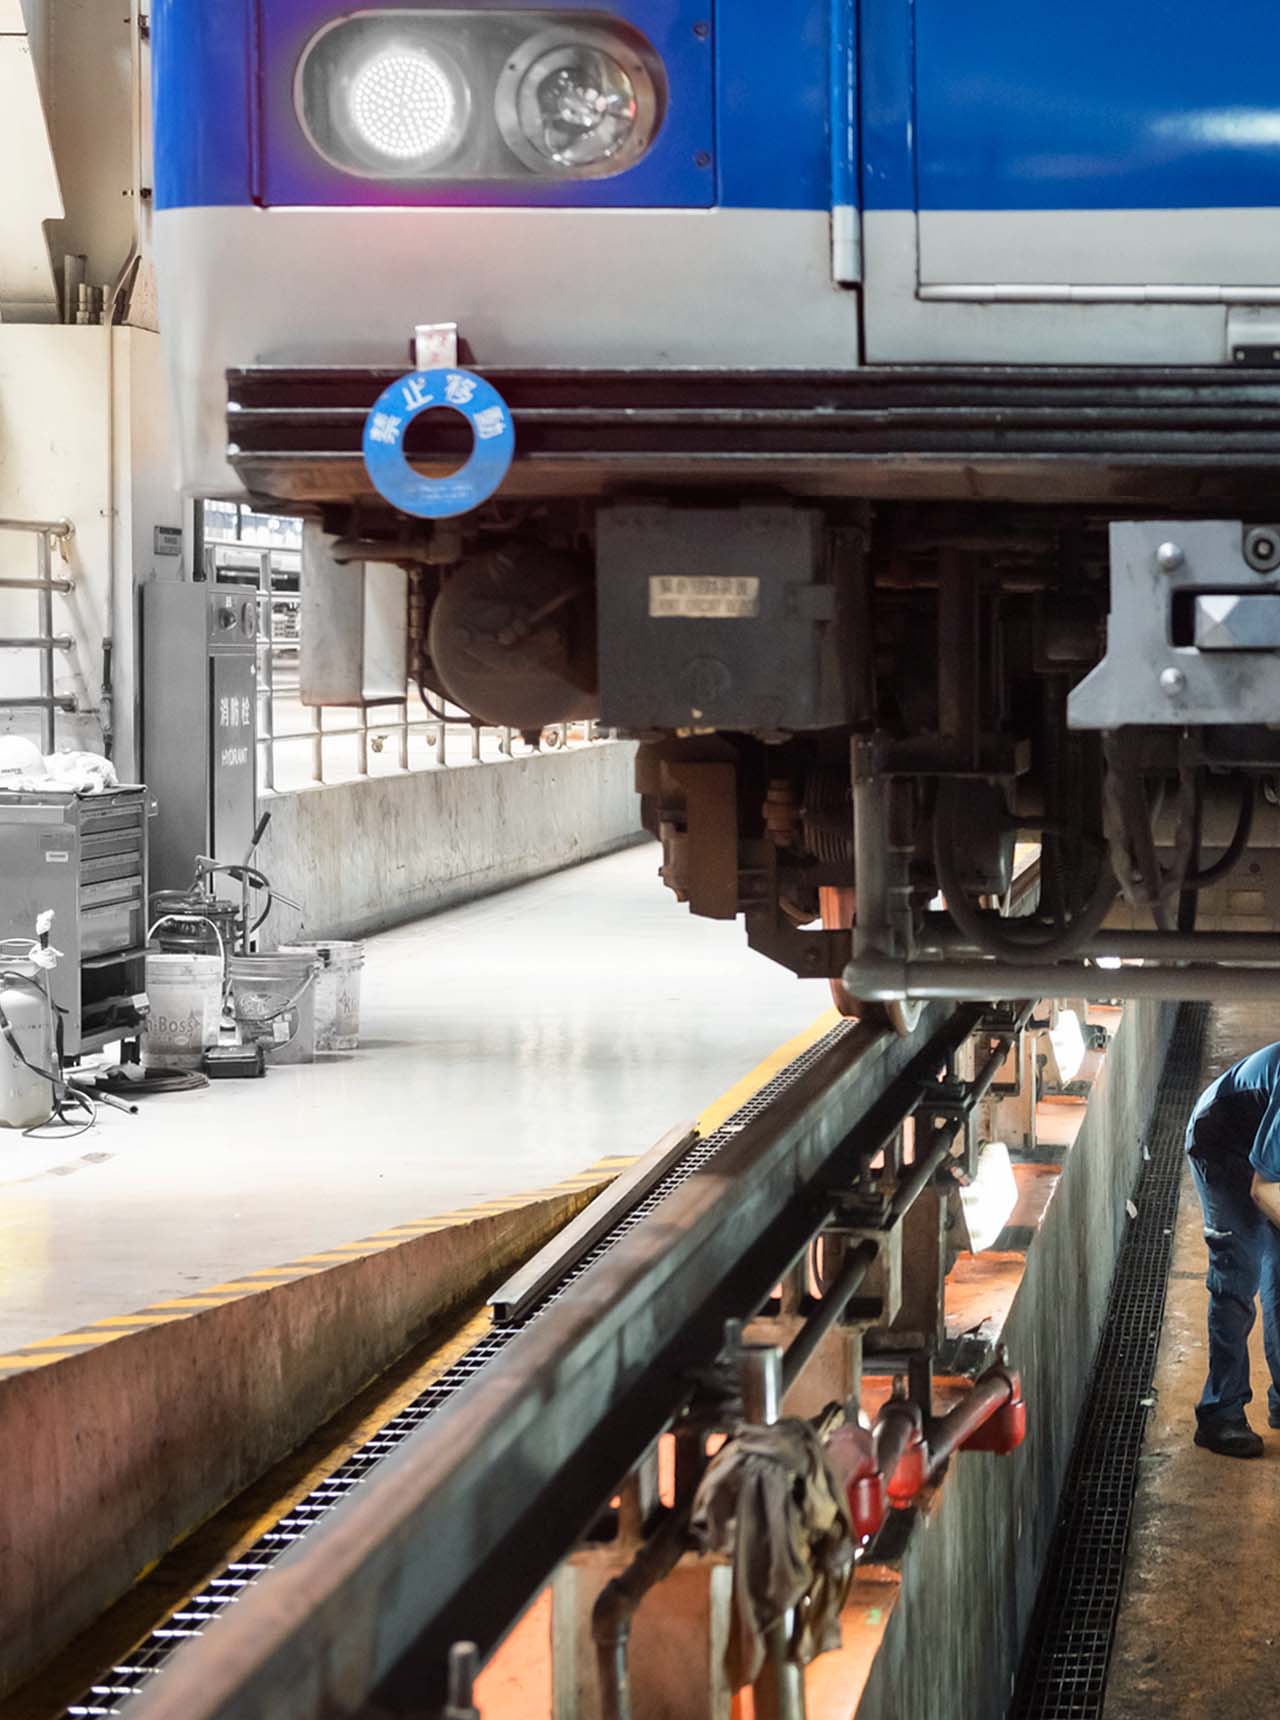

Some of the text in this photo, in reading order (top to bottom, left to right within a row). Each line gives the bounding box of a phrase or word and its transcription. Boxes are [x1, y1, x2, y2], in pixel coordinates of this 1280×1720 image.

[369, 373, 506, 444] 禁止移動
[220, 696, 250, 727] 消防栓
